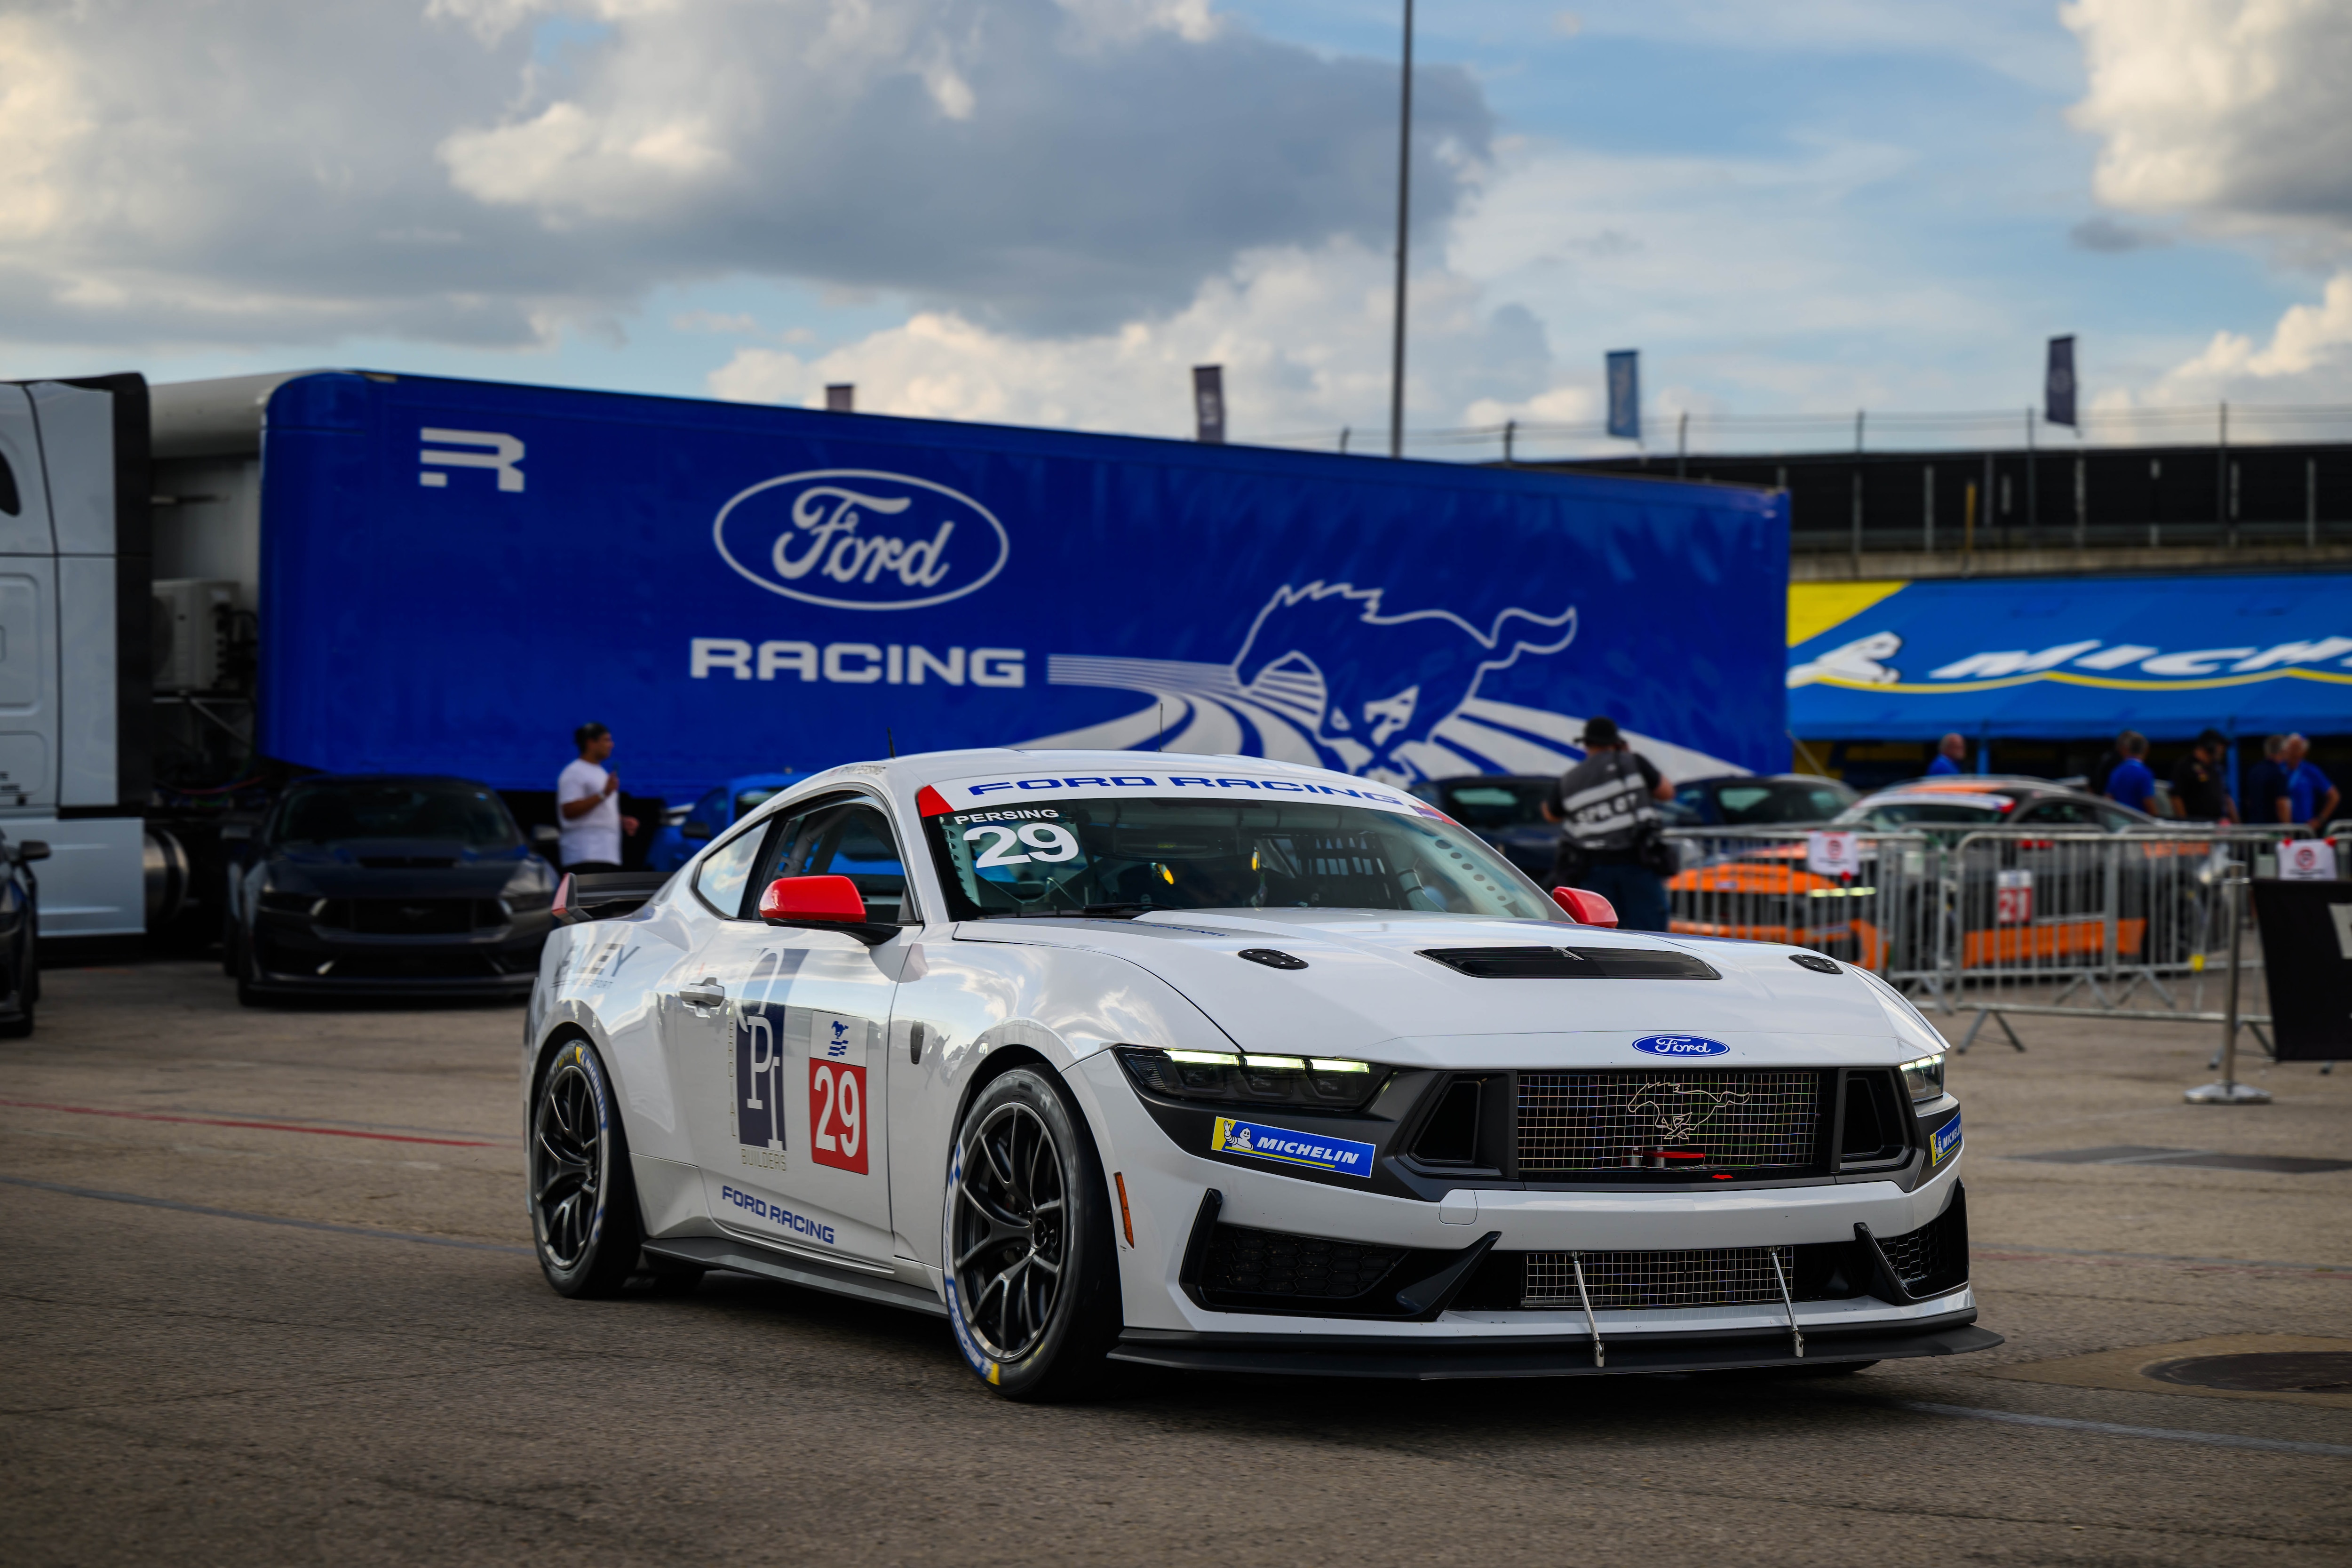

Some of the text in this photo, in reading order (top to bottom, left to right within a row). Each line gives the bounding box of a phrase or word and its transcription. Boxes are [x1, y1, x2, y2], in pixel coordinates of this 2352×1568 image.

[772, 486, 954, 587] Ford
[690, 637, 1025, 688] RACING
[1928, 635, 2352, 679] MICH
[968, 776, 1404, 805] FORD RACING
[954, 809, 1059, 825] PERSING
[962, 822, 1079, 868] 29
[1654, 1037, 1711, 1053] Ford
[814, 1065, 860, 1157] 29
[741, 1148, 787, 1172] BUILDERS
[1256, 1137, 1359, 1164] MICHELIN
[722, 1185, 834, 1245] FORD RACING
